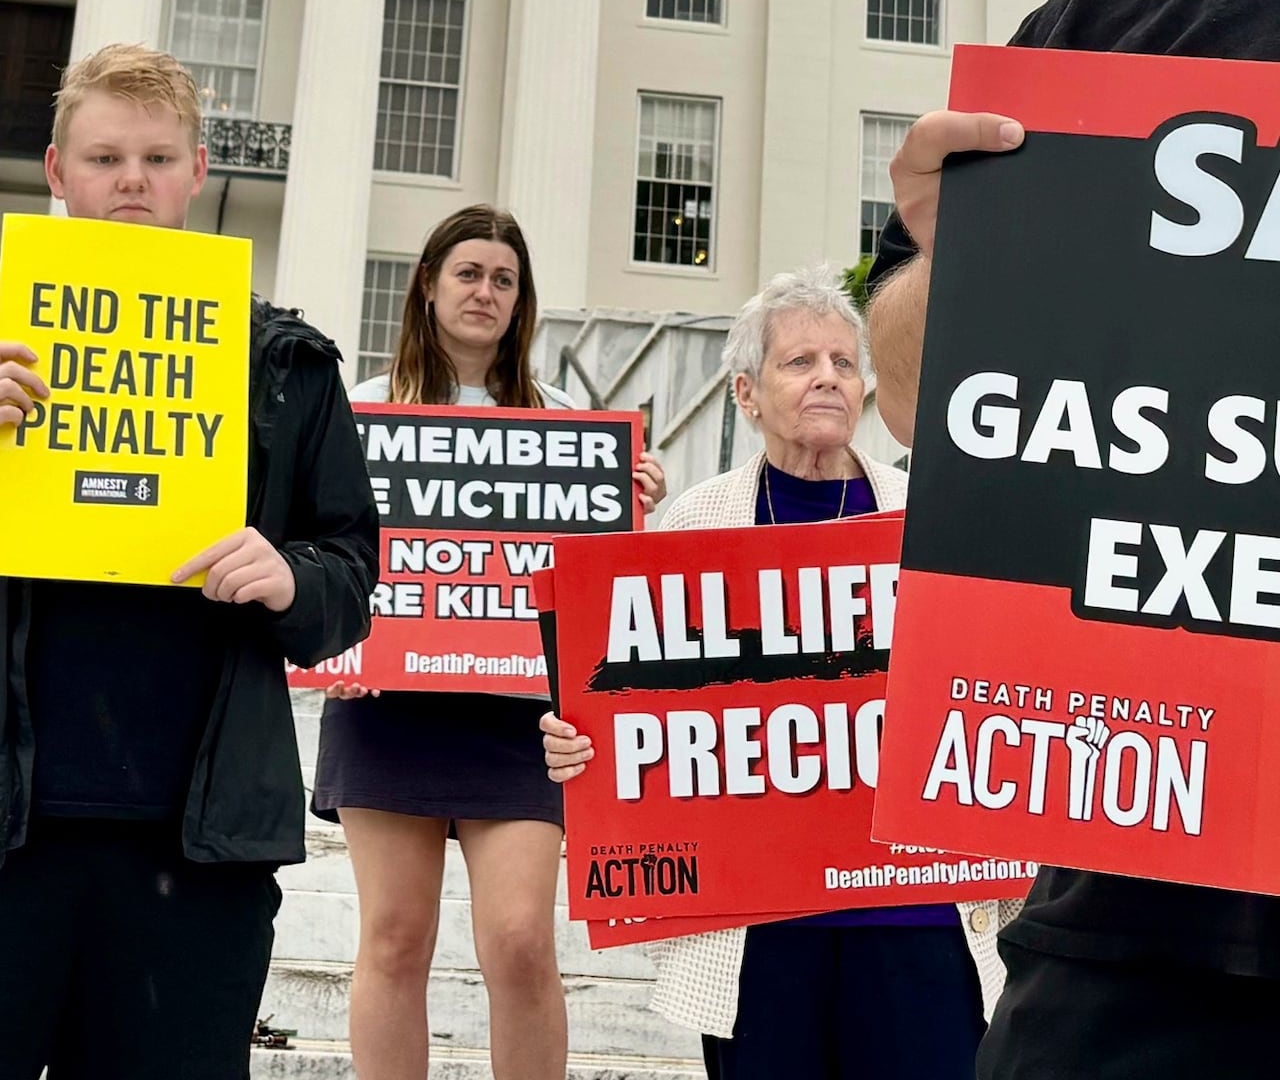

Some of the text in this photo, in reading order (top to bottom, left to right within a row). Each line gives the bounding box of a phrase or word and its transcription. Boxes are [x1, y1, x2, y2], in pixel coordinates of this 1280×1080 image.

[30, 282, 219, 344] END THE
[50, 343, 193, 399] DEATH
[16, 402, 224, 458] PENALTY
[356, 423, 618, 468] MEMBER
[947, 371, 1169, 475] GAS
[81, 477, 128, 490] AMNESTY
[406, 478, 621, 522] VICTIMS
[391, 539, 554, 572] NOT W
[438, 584, 539, 618] KILL
[607, 572, 740, 662] ALL
[951, 677, 1215, 731] DEATH PENALTY
[922, 709, 1207, 836] ACTION
[591, 842, 698, 856] DEATH PENALTY
[585, 854, 698, 898] ACTION
